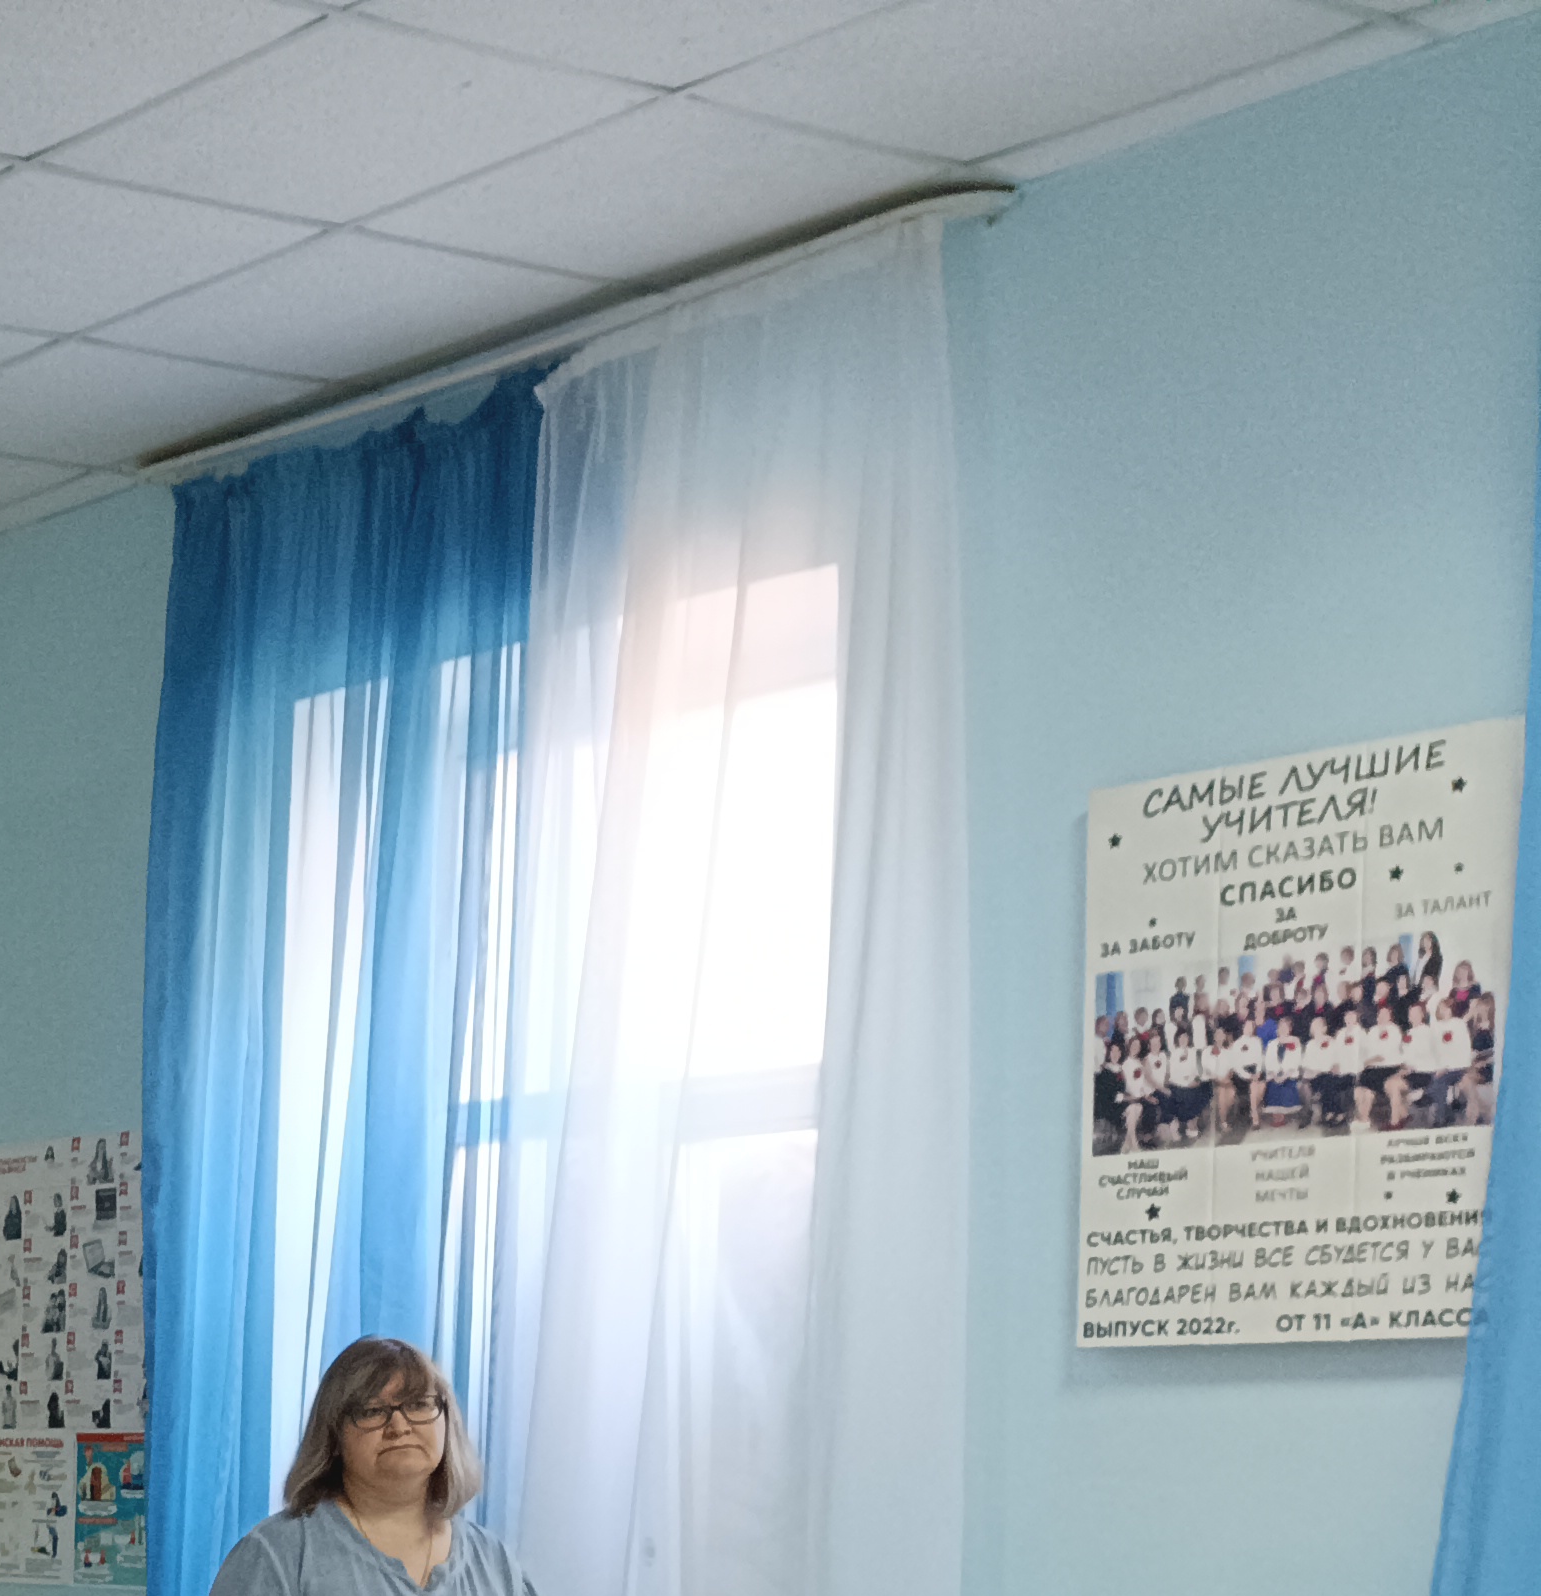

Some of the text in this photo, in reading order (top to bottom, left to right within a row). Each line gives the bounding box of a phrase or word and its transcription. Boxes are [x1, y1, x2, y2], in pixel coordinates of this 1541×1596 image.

[1143, 739, 1447, 819] САМЫЕ ЛУЧШИЕ
[1200, 788, 1378, 844] УЧИТЕЛЯ!
[1142, 816, 1445, 885] ХОТИМ СКАЗАТЬ ВАМ
[1220, 867, 1357, 907] СПАСИБО
[1275, 906, 1297, 923] ЗА
[1394, 890, 1493, 920] ЗА ТАЛАНТ
[1100, 931, 1196, 958] ЗА ЗАБОТУ
[1243, 923, 1328, 951] ДОБРОТУ
[1086, 1227, 1178, 1248] СЧАСТЬЯ,
[1183, 1219, 1309, 1242] ТВОРЧЕСТВА
[1315, 1217, 1329, 1234] И
[1086, 1254, 1144, 1276] ПУСТЬ
[1153, 1252, 1166, 1274] В
[1176, 1249, 1244, 1273] ЖИЗНИ
[1254, 1245, 1295, 1269] ВСЕ
[1304, 1239, 1410, 1266] СБУДЕТСЯ
[1421, 1240, 1435, 1259] У
[1085, 1272, 1480, 1309] БЛАГОДАРЕН ВАМ КАЖДЫЙ ИЗ НА
[1083, 1318, 1170, 1339] ВЫПУСК
[1176, 1316, 1241, 1336] 2022г.
[1275, 1313, 1306, 1333] ОТ
[1313, 1313, 1331, 1331] 11
